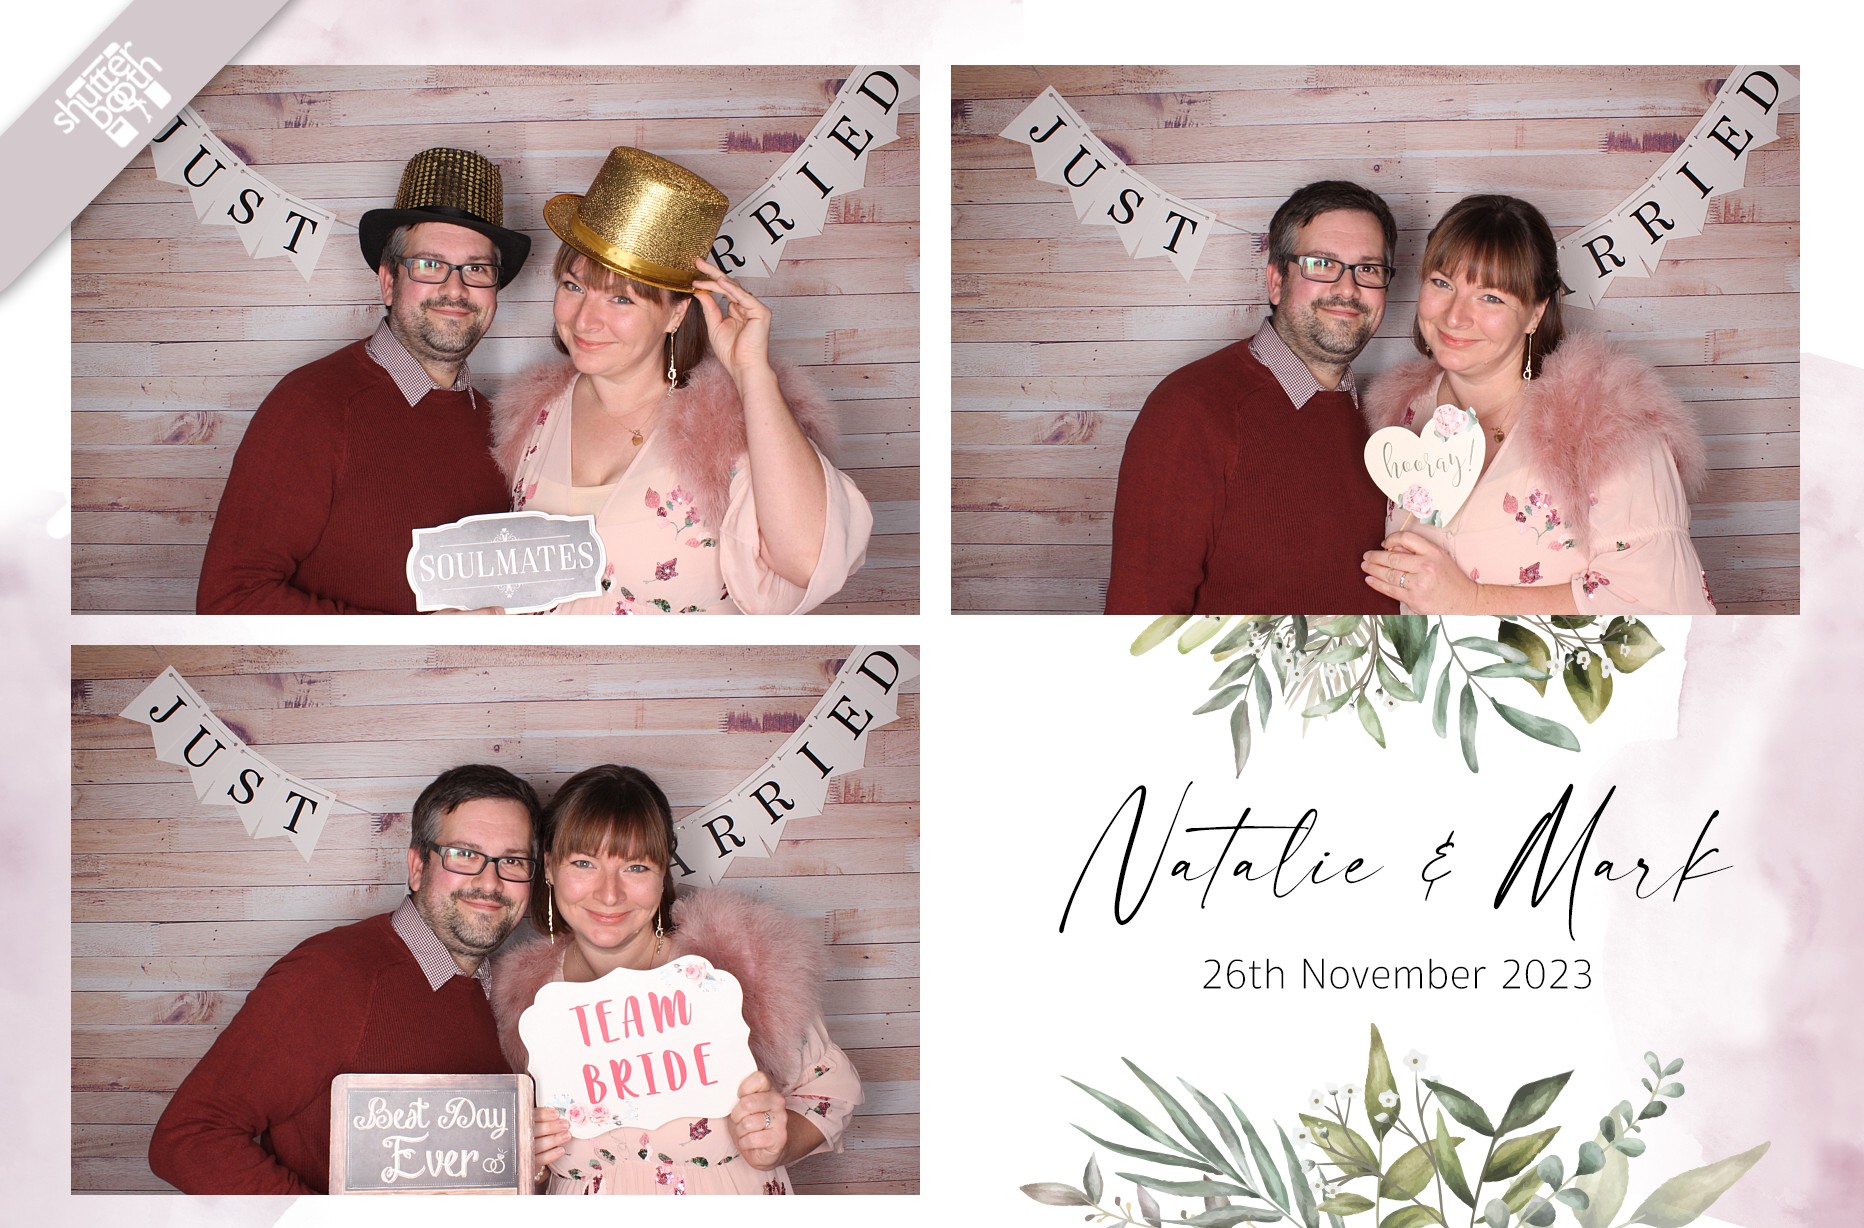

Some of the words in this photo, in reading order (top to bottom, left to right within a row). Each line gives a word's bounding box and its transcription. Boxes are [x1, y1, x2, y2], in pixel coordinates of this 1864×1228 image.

[152, 115, 318, 254] JUST
[1029, 115, 1198, 254] JUST
[1560, 70, 1780, 297] RRIED
[1382, 438, 1475, 488] hooray!
[419, 541, 594, 583] SOULMATES
[149, 695, 318, 834] JUST
[569, 989, 692, 1047] TEAM
[582, 1042, 718, 1105] BRIDE
[353, 1097, 430, 1131] Best
[437, 1097, 509, 1140] Day
[381, 1131, 479, 1184] Ever
